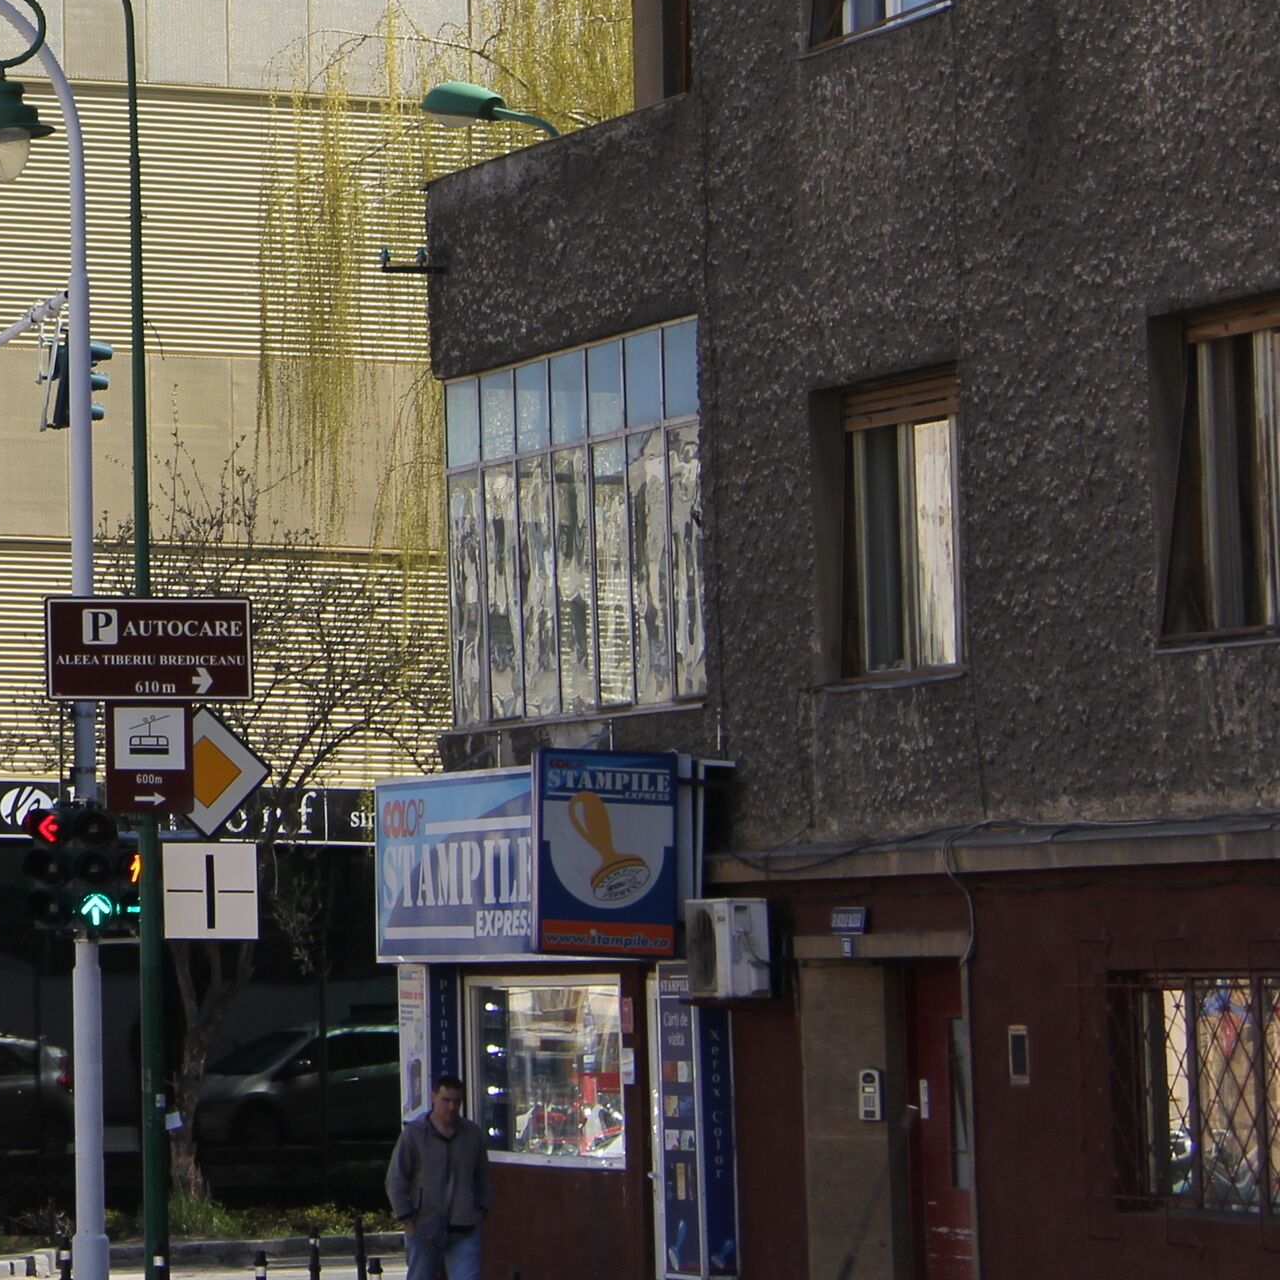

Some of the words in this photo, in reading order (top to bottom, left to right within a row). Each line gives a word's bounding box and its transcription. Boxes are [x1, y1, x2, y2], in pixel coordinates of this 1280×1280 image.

[122, 619, 244, 637] AUTOCARE
[55, 654, 100, 666] ALEEA
[102, 654, 156, 666] TIBERIU
[159, 654, 246, 667] BREDICEANU
[134, 680, 160, 694] 610
[162, 683, 176, 694] m
[135, 773, 163, 785] 600m
[547, 769, 670, 793] STAMPILE
[624, 791, 670, 801] EXPRESS
[382, 798, 425, 839] COLOP
[383, 835, 532, 910] STAMPILE
[544, 928, 670, 950] www.stampile.ro
[708, 1028, 722, 1098] Xerox
